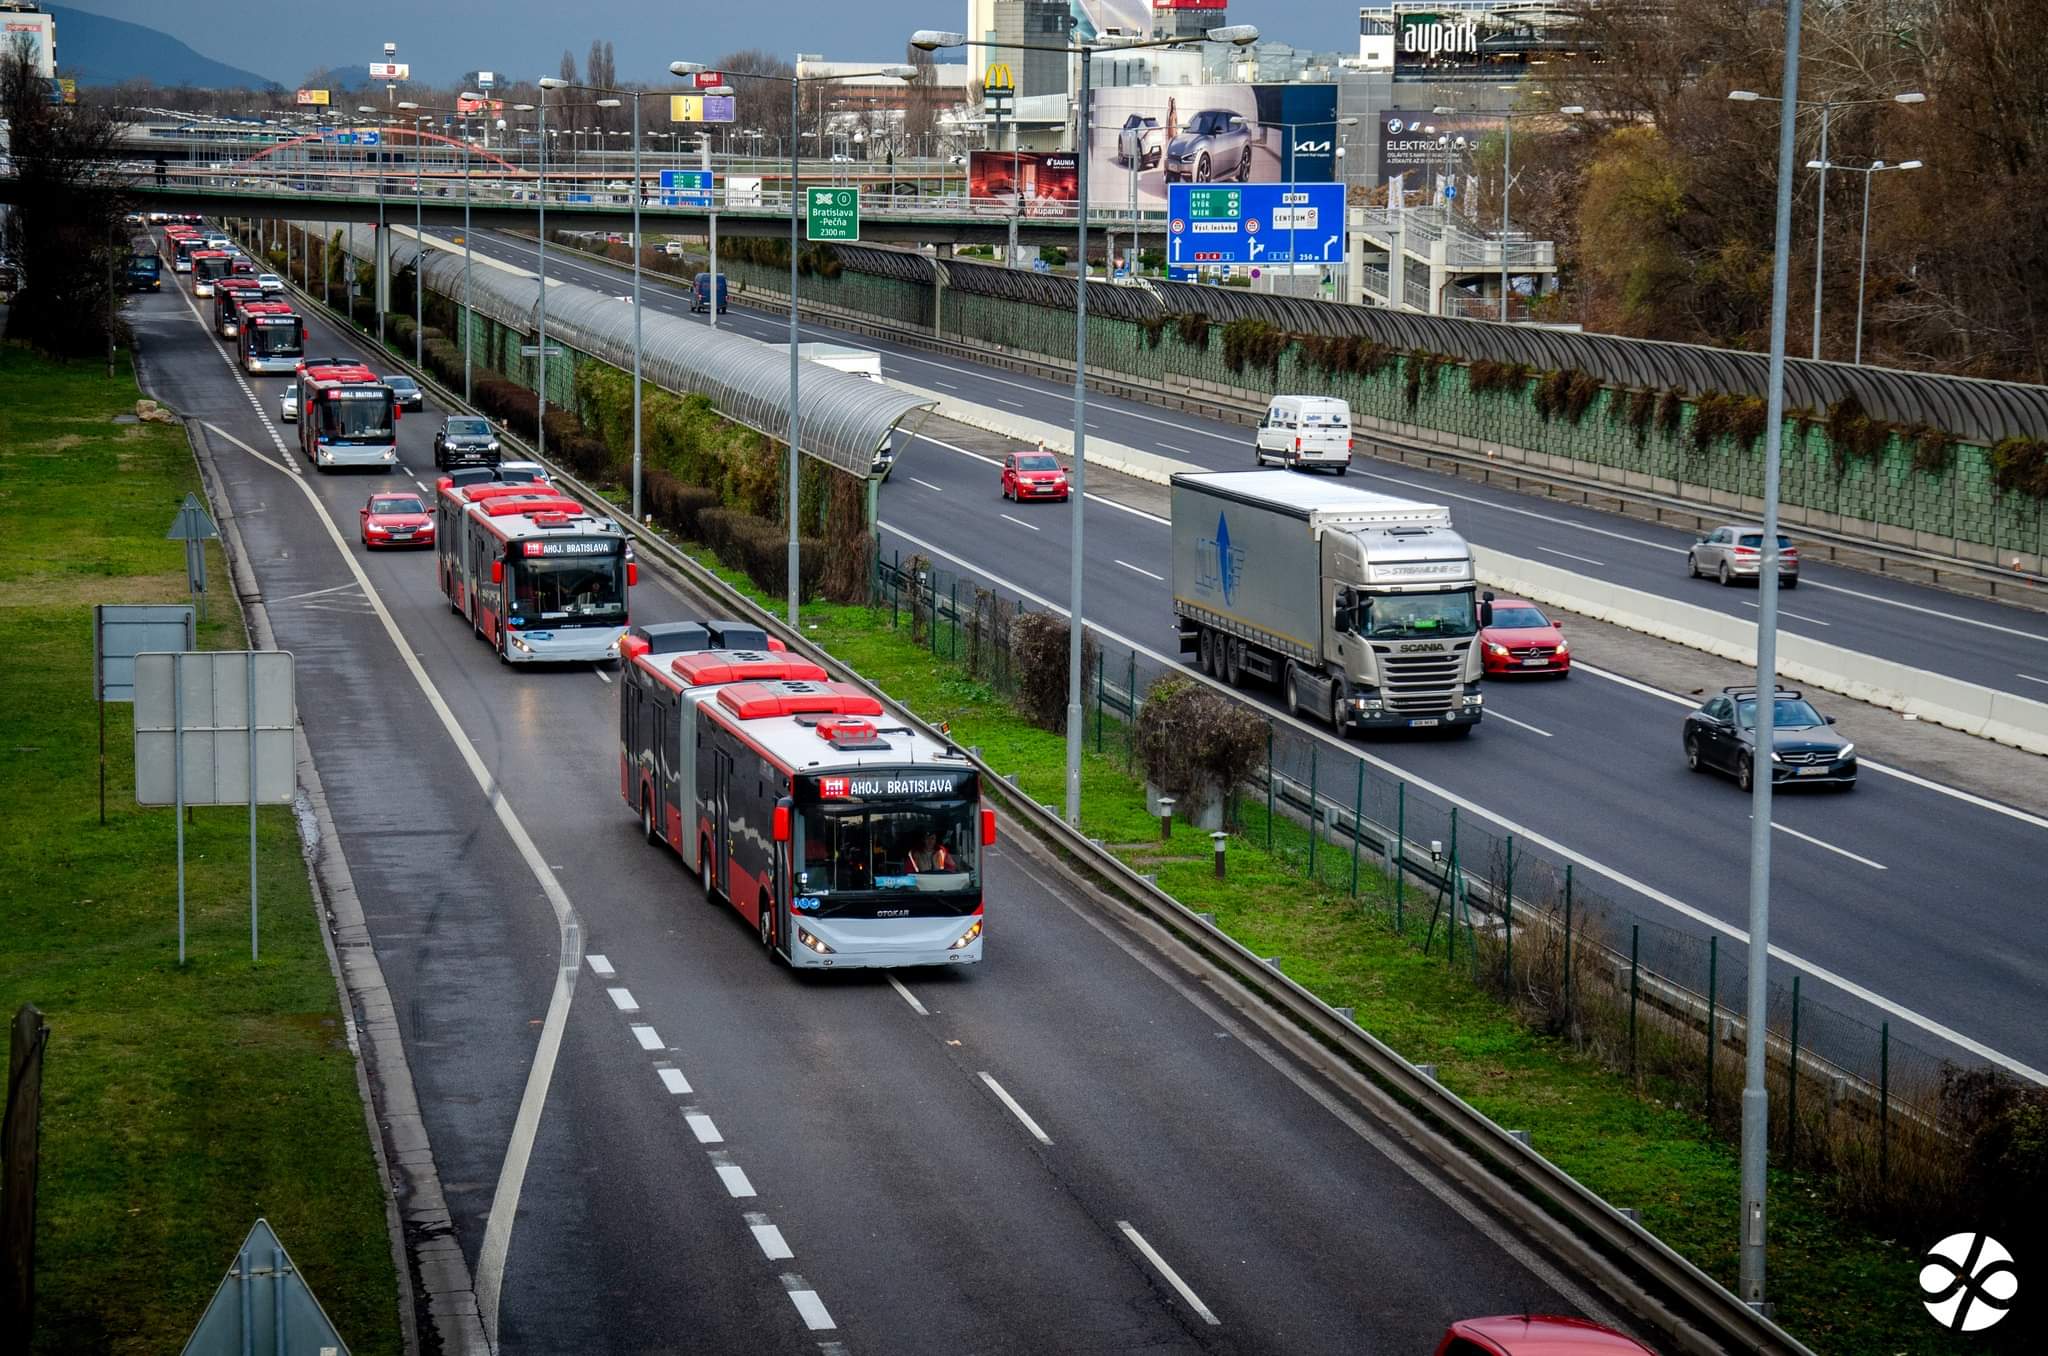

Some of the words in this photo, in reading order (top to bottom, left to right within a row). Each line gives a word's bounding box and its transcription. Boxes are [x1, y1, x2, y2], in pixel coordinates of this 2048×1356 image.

[1405, 17, 1477, 58] aupark
[812, 208, 853, 217] Bratislava
[820, 228, 838, 236] 2300
[566, 543, 608, 553] BRATISLAVA
[1400, 643, 1445, 653] SCANIA
[887, 779, 953, 794] BRATISLAVA
[877, 909, 910, 917] OTOKAR
